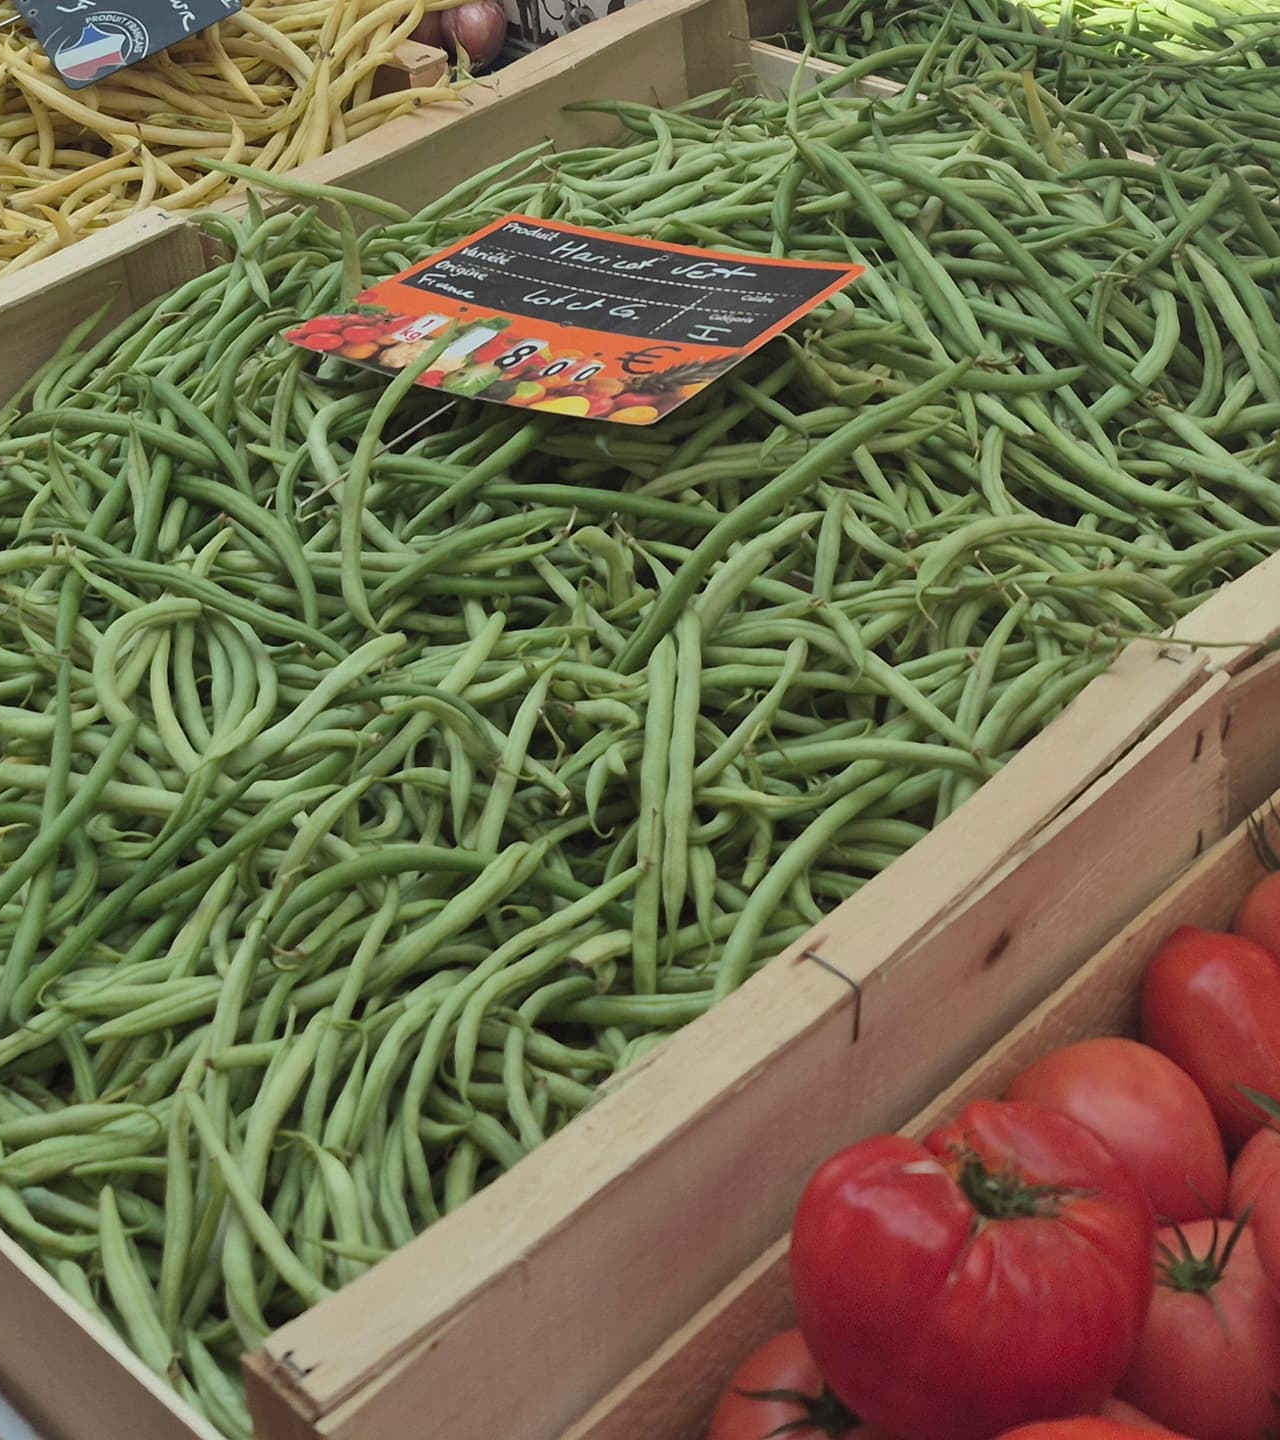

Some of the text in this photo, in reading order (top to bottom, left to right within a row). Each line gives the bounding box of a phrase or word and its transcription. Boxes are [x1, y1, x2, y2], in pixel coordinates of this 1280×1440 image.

[84, 13, 147, 55] PRODUIT FRANÇAIS
[460, 245, 517, 267] Variété
[501, 222, 562, 243] Produit
[549, 240, 663, 271] Haricot
[434, 259, 489, 282] Origine
[417, 272, 476, 300] France
[399, 328, 422, 342] kg
[421, 318, 436, 329] 1
[615, 346, 683, 376] €
